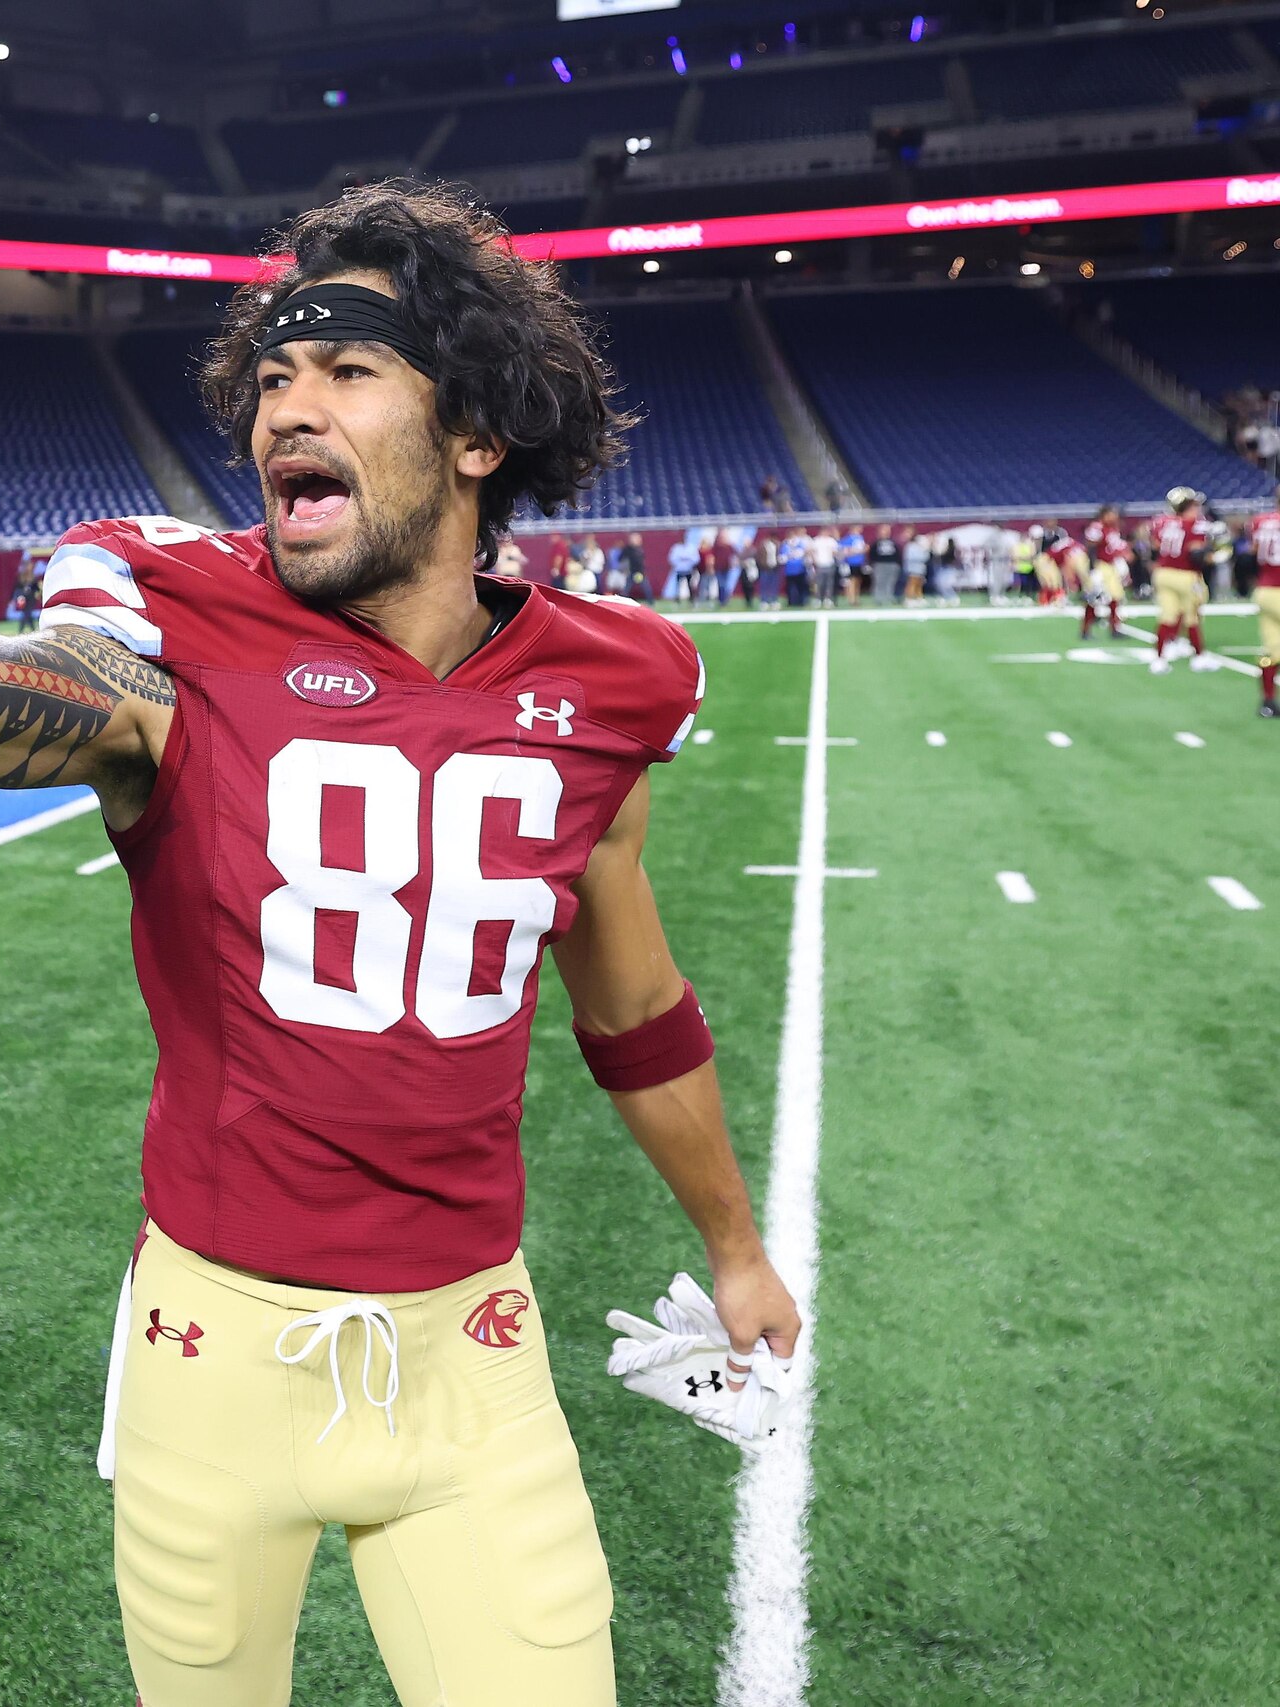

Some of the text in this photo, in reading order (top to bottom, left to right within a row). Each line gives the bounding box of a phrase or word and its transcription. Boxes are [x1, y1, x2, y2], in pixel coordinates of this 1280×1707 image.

[629, 223, 704, 251] Rocket
[303, 672, 361, 695] UFL
[258, 738, 565, 1040] 86
